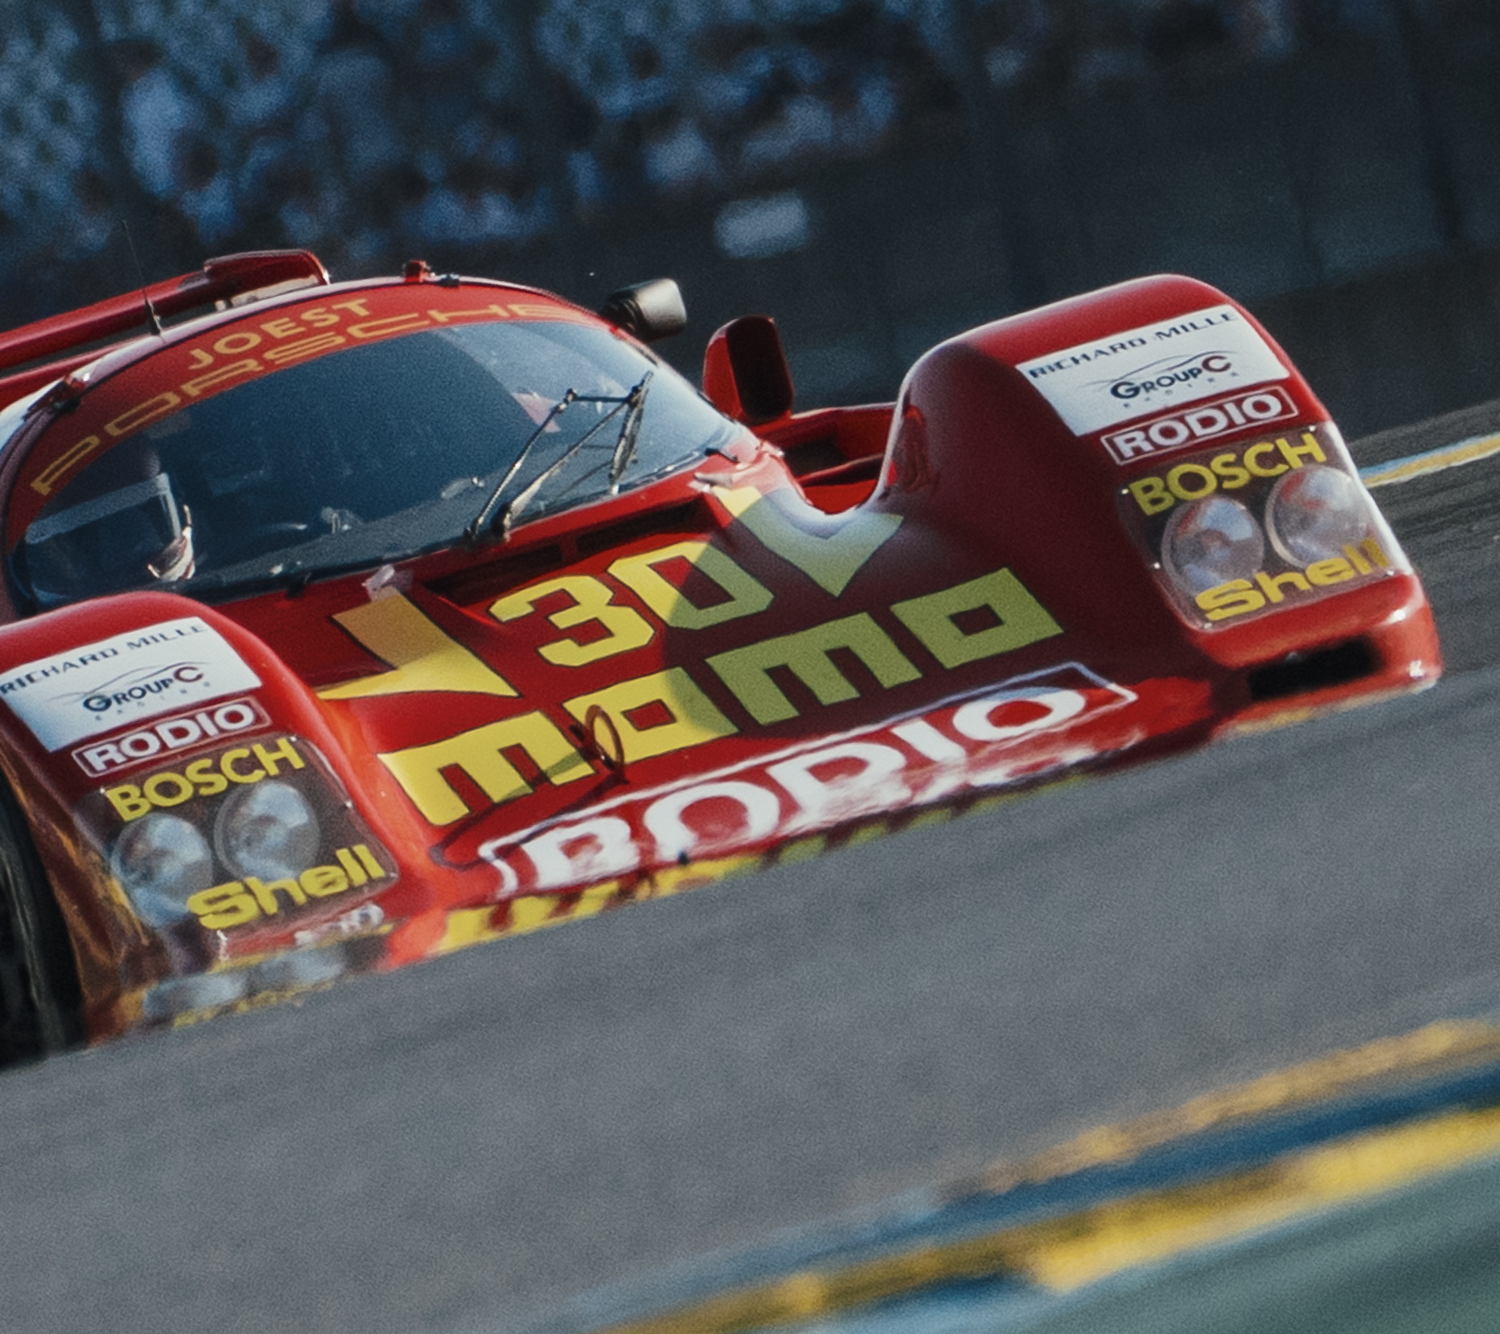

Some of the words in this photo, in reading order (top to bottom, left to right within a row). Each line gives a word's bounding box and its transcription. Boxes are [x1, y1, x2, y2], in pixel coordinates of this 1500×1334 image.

[188, 298, 370, 369] JOEST
[1028, 337, 1146, 379] RICHARD
[1156, 312, 1238, 341] MILLE
[30, 303, 595, 496] PORSCHE
[1114, 394, 1282, 458] RODIO
[1128, 433, 1327, 516] BOSCH
[488, 540, 775, 668] 30
[1195, 538, 1391, 621] Shell
[126, 624, 207, 650] MILLE
[82, 701, 255, 772] RODIO
[376, 566, 1064, 826] momo
[107, 738, 304, 822] BOSCH
[187, 844, 386, 930] Shell
